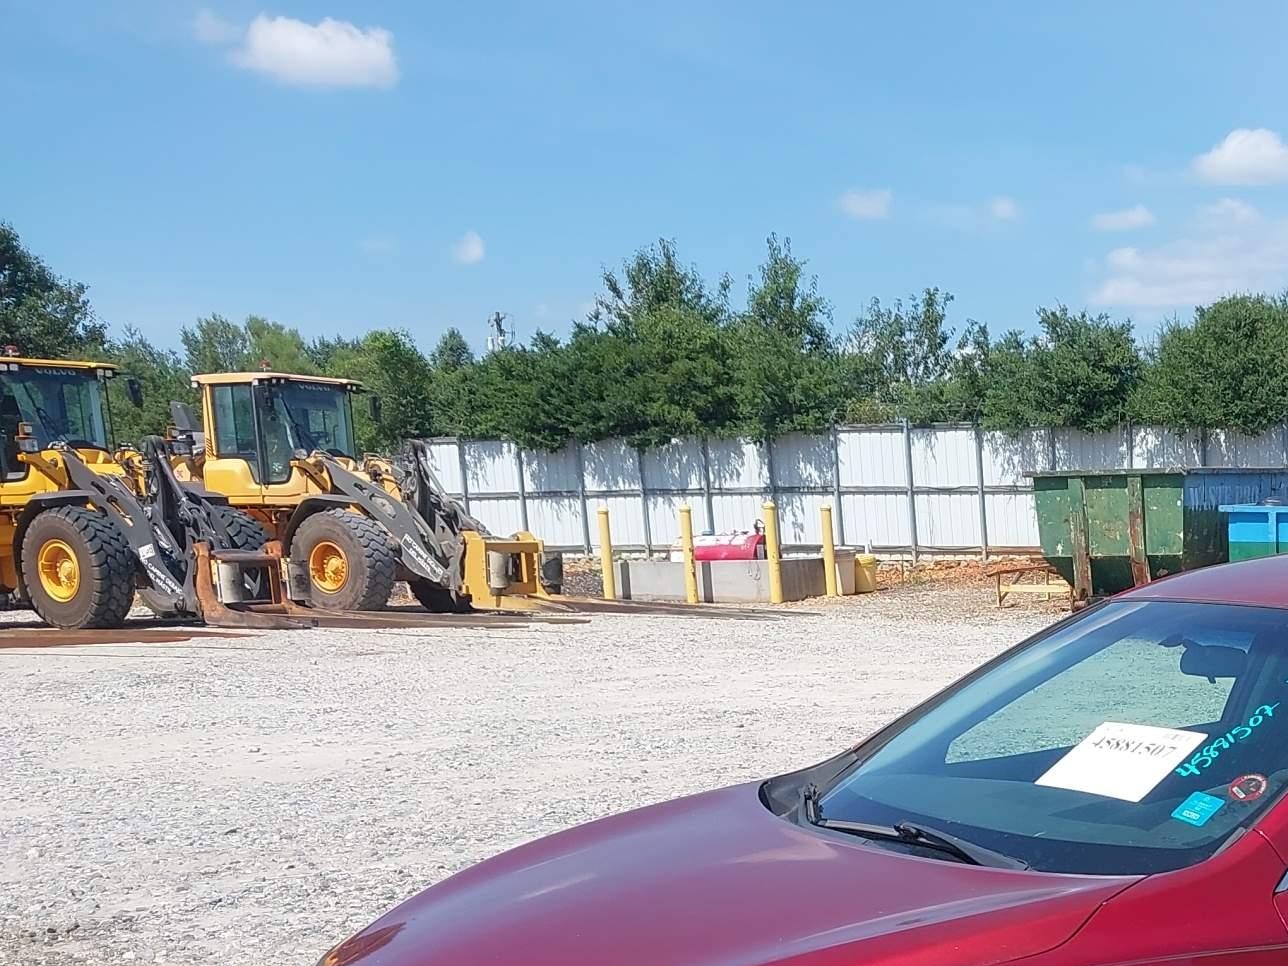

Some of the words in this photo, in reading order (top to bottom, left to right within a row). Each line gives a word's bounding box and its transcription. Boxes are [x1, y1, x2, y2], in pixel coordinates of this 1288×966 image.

[34, 367, 77, 376] VOLVO
[1091, 736, 1177, 759] 45881507
[1175, 702, 1280, 777] 45881507
